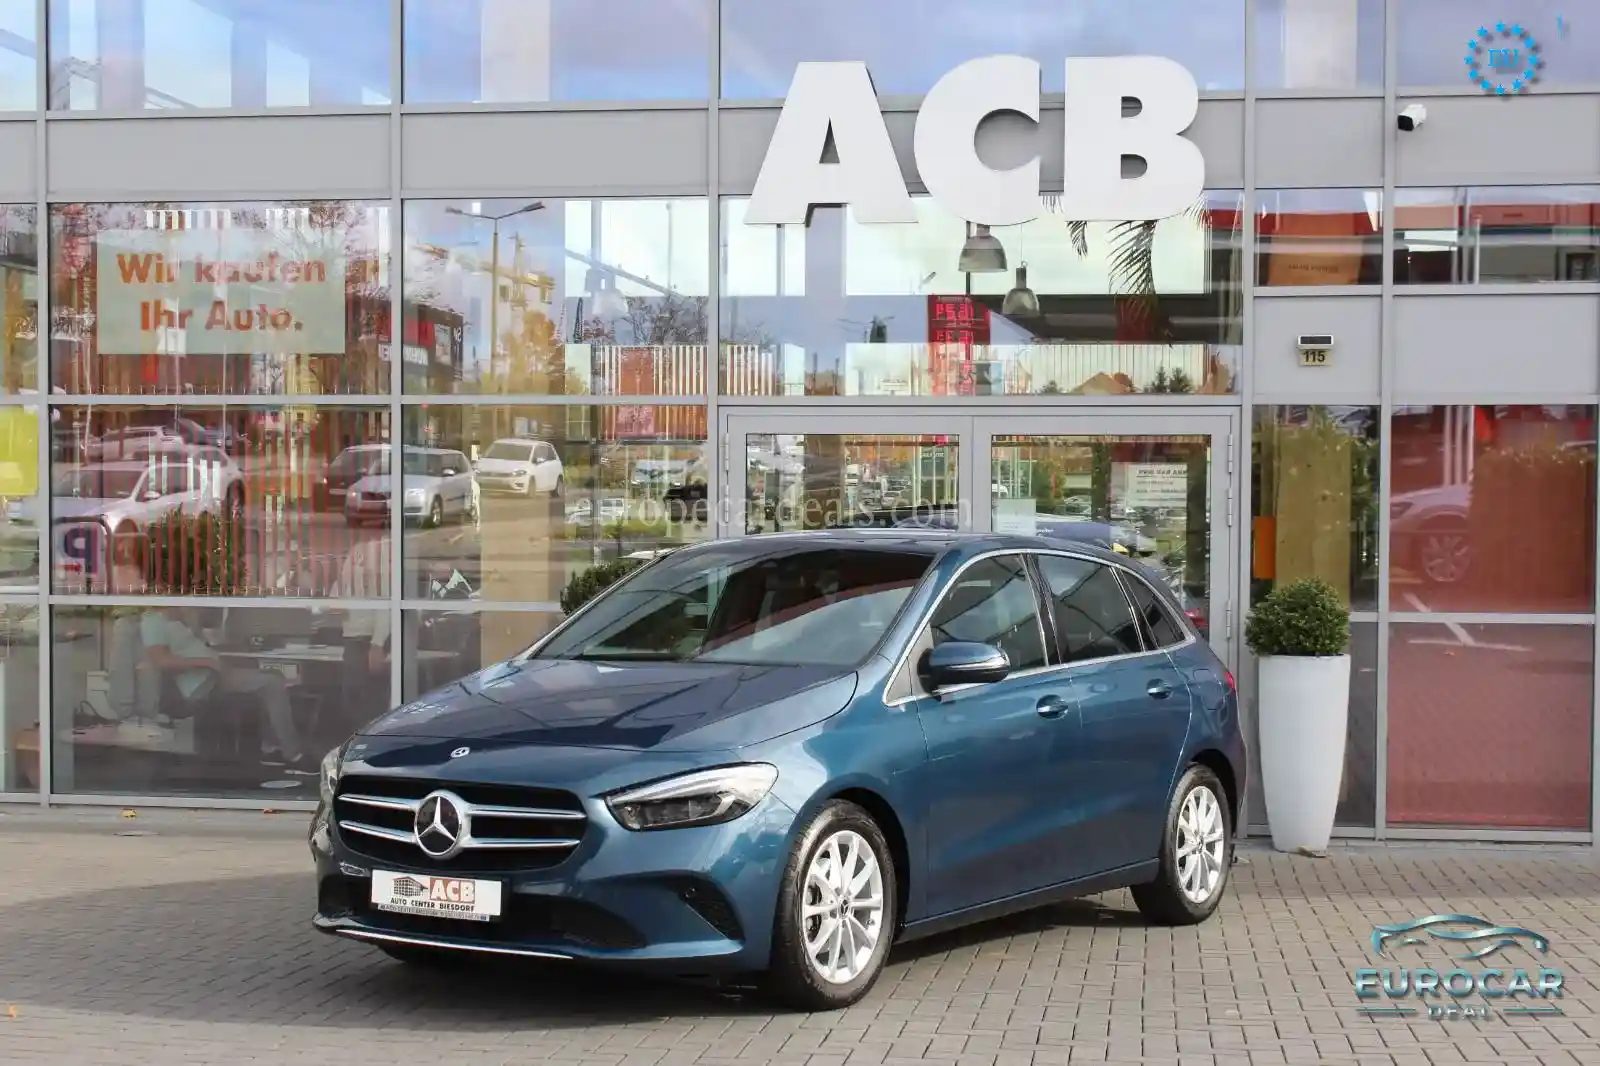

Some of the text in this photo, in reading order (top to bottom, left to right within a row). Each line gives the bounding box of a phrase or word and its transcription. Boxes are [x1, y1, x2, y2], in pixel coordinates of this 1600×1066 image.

[743, 55, 1205, 226] ACB
[116, 251, 326, 284] Wir kaufen
[140, 300, 303, 331] Ihr Auto.
[1302, 350, 1326, 363] 115
[430, 879, 475, 902] ACB
[390, 897, 475, 912] AUTO CENTER BIESDORF
